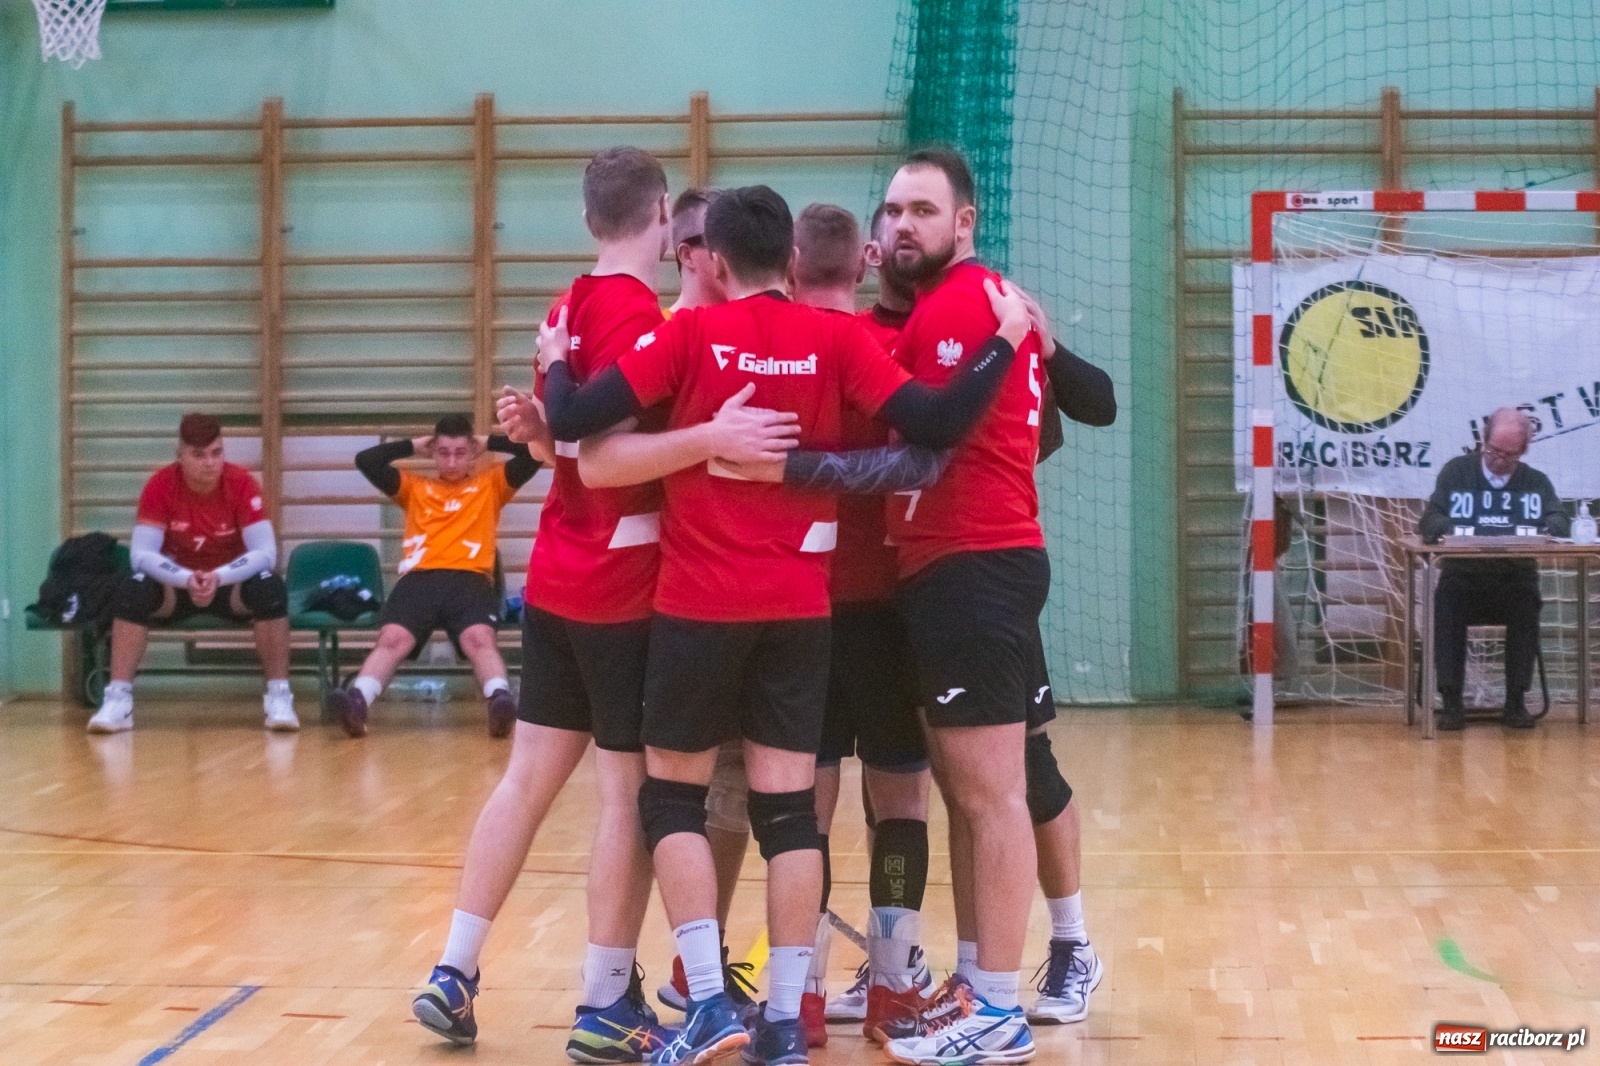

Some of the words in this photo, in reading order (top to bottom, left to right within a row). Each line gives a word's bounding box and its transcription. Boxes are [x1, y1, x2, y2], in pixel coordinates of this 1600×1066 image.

[1327, 196, 1359, 207] sport
[738, 352, 818, 375] Galmet
[973, 350, 998, 372] KIPSTA
[1278, 435, 1432, 468] RACIBÓRZ
[1450, 491, 1474, 519] 20
[1482, 490, 1493, 509] 0
[1502, 492, 1512, 510] 2
[1520, 493, 1542, 519] 19
